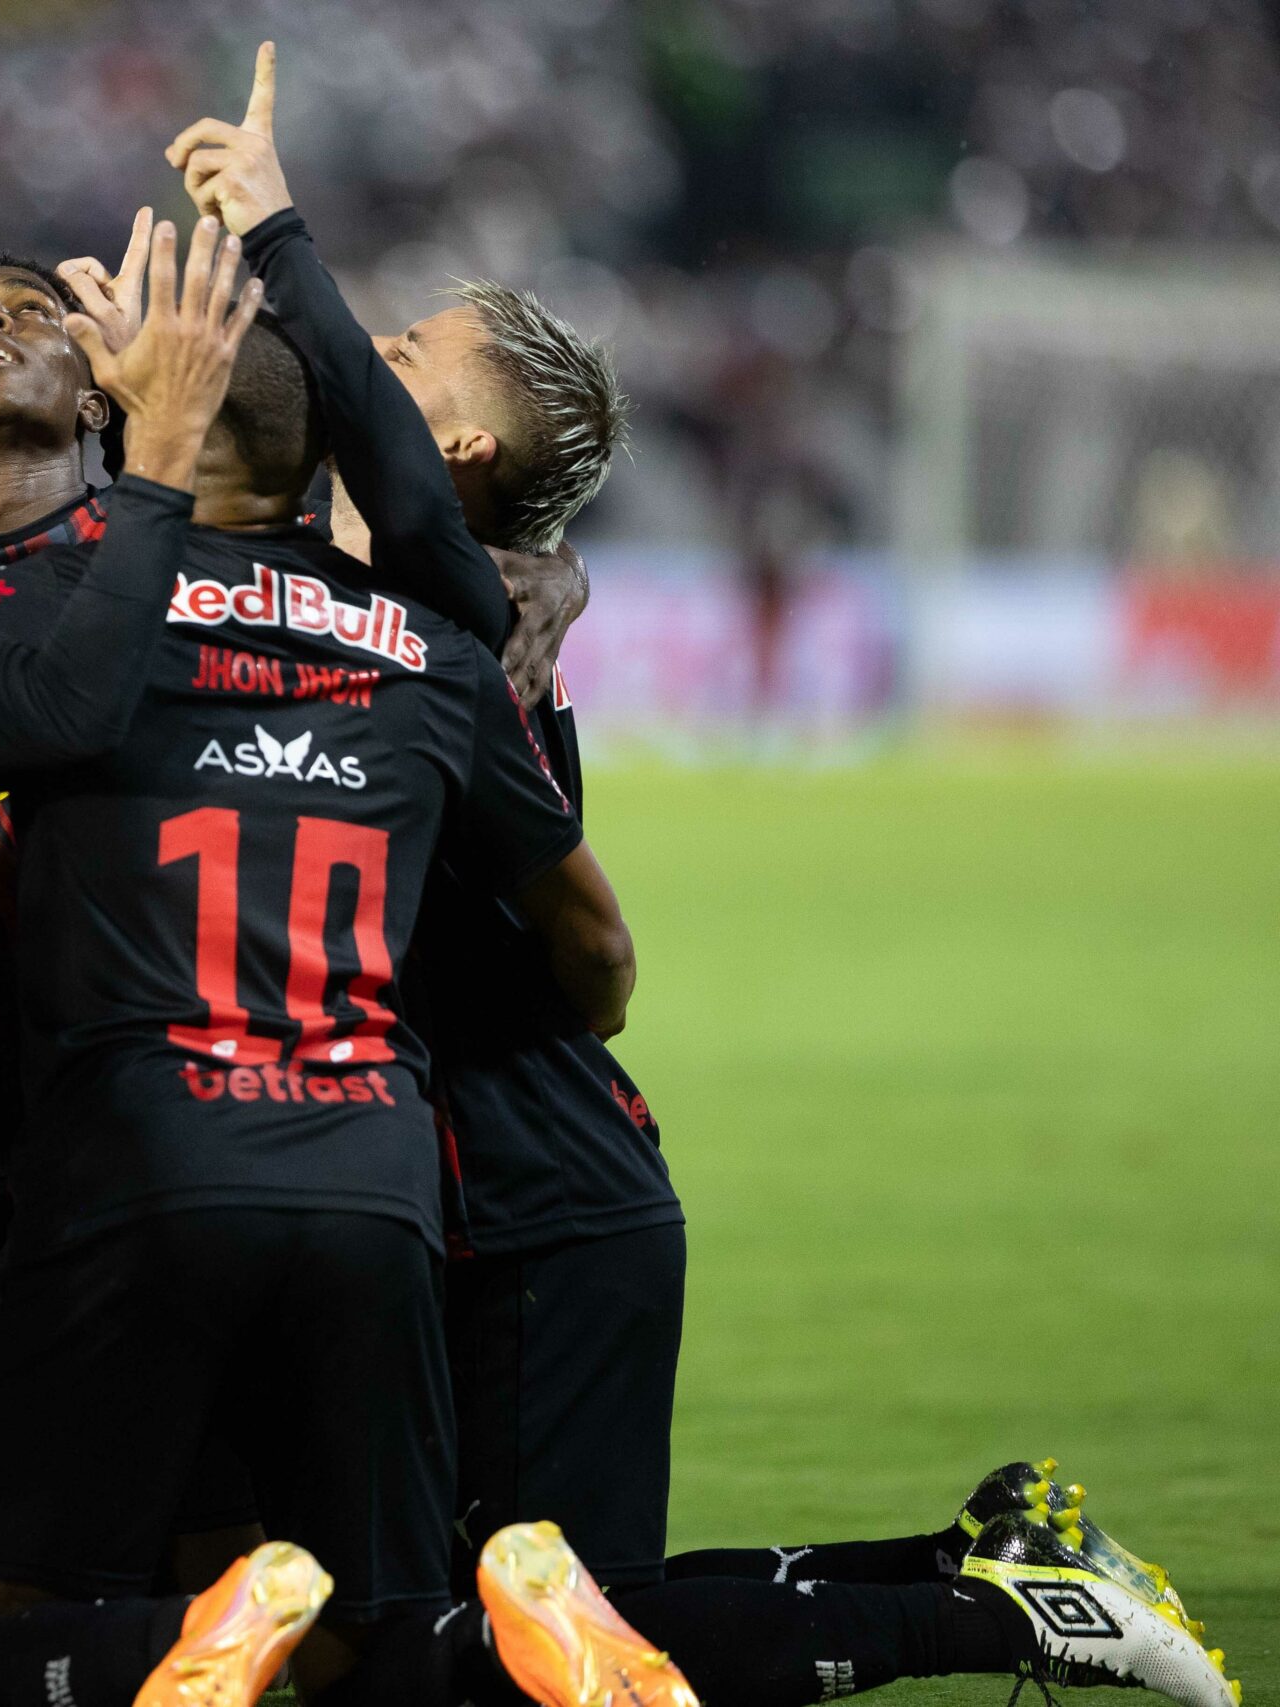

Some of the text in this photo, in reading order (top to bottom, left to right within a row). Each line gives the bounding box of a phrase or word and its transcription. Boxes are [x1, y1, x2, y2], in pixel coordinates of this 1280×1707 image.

[192, 644, 285, 697] JHON
[283, 573, 429, 673] Bulls
[158, 806, 397, 1065] 10
